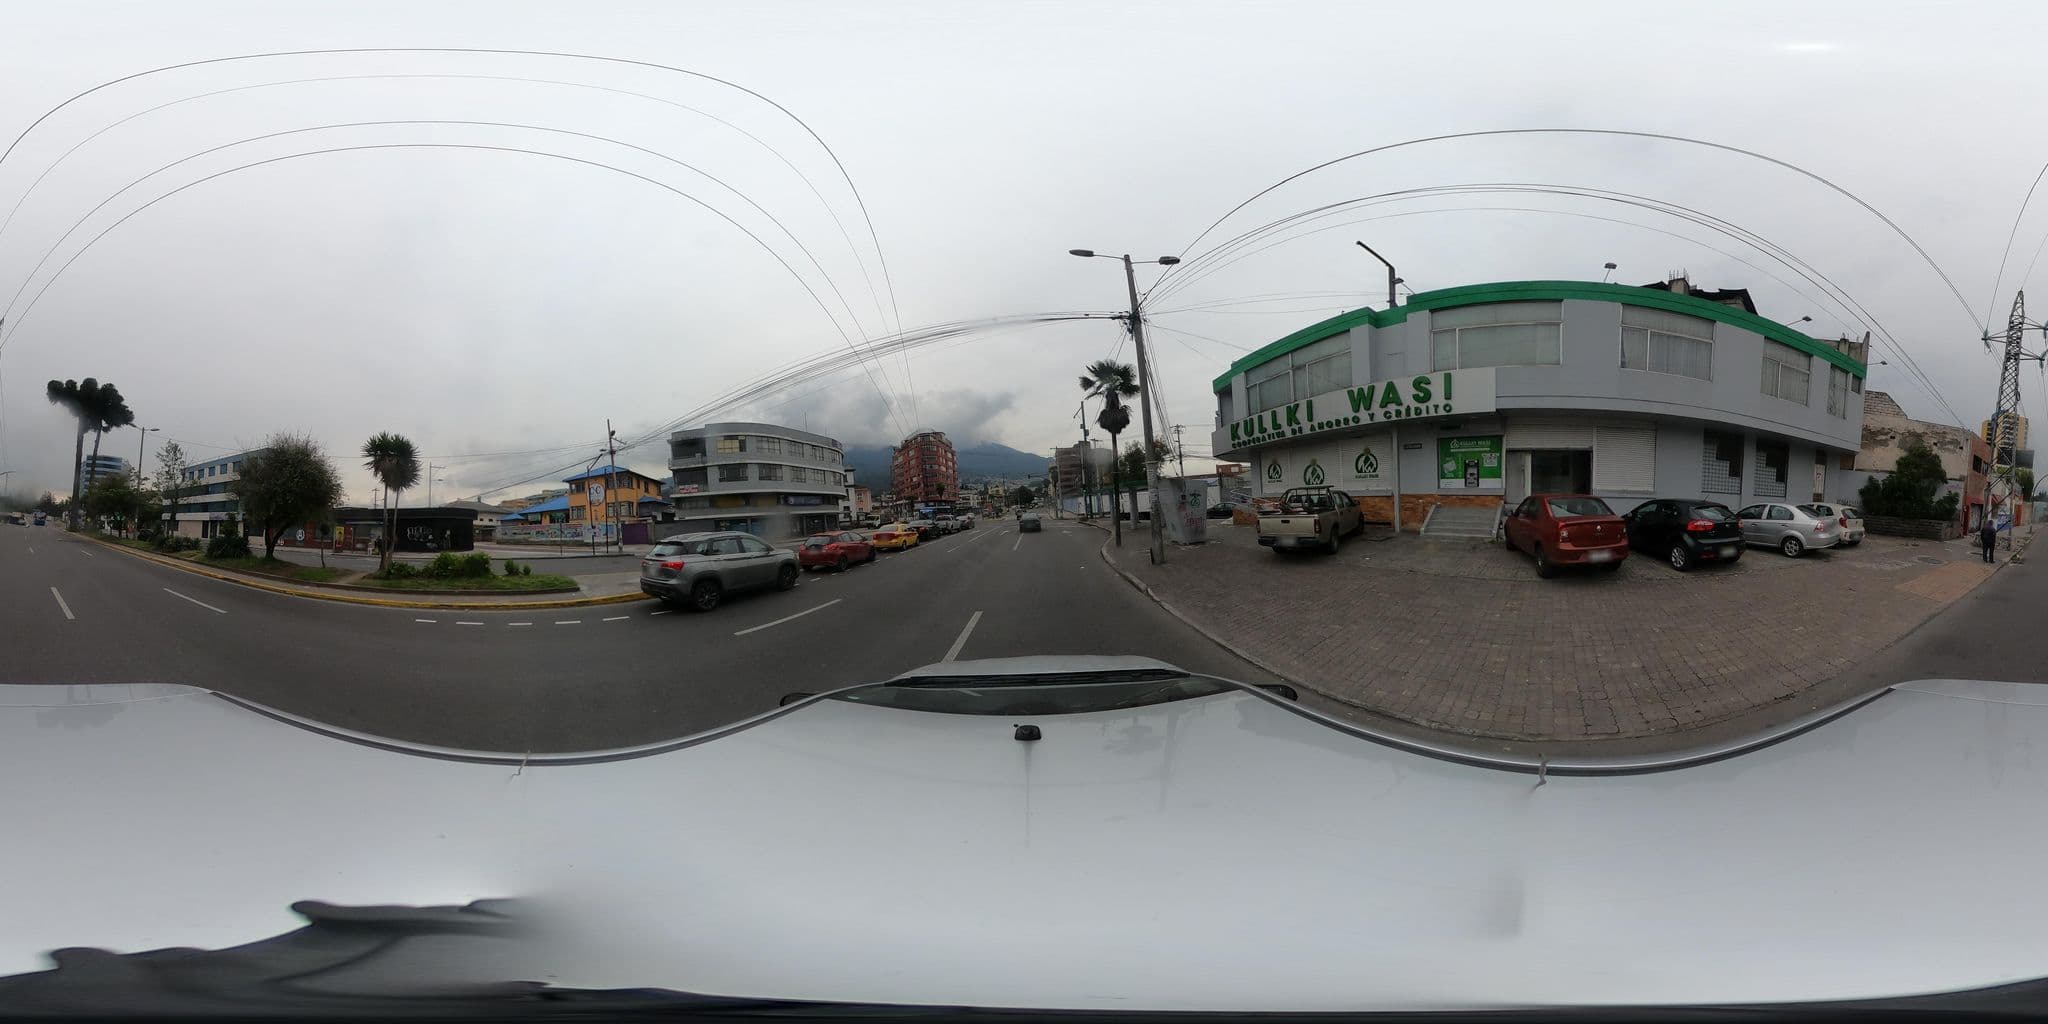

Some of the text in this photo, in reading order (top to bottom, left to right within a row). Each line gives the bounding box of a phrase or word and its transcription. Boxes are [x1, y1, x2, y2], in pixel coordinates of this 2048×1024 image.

[1231, 372, 1452, 441] KULLKI WASI
[1232, 403, 1452, 448] COOPERATIVA DE AHORRO Y CRÉDITO
